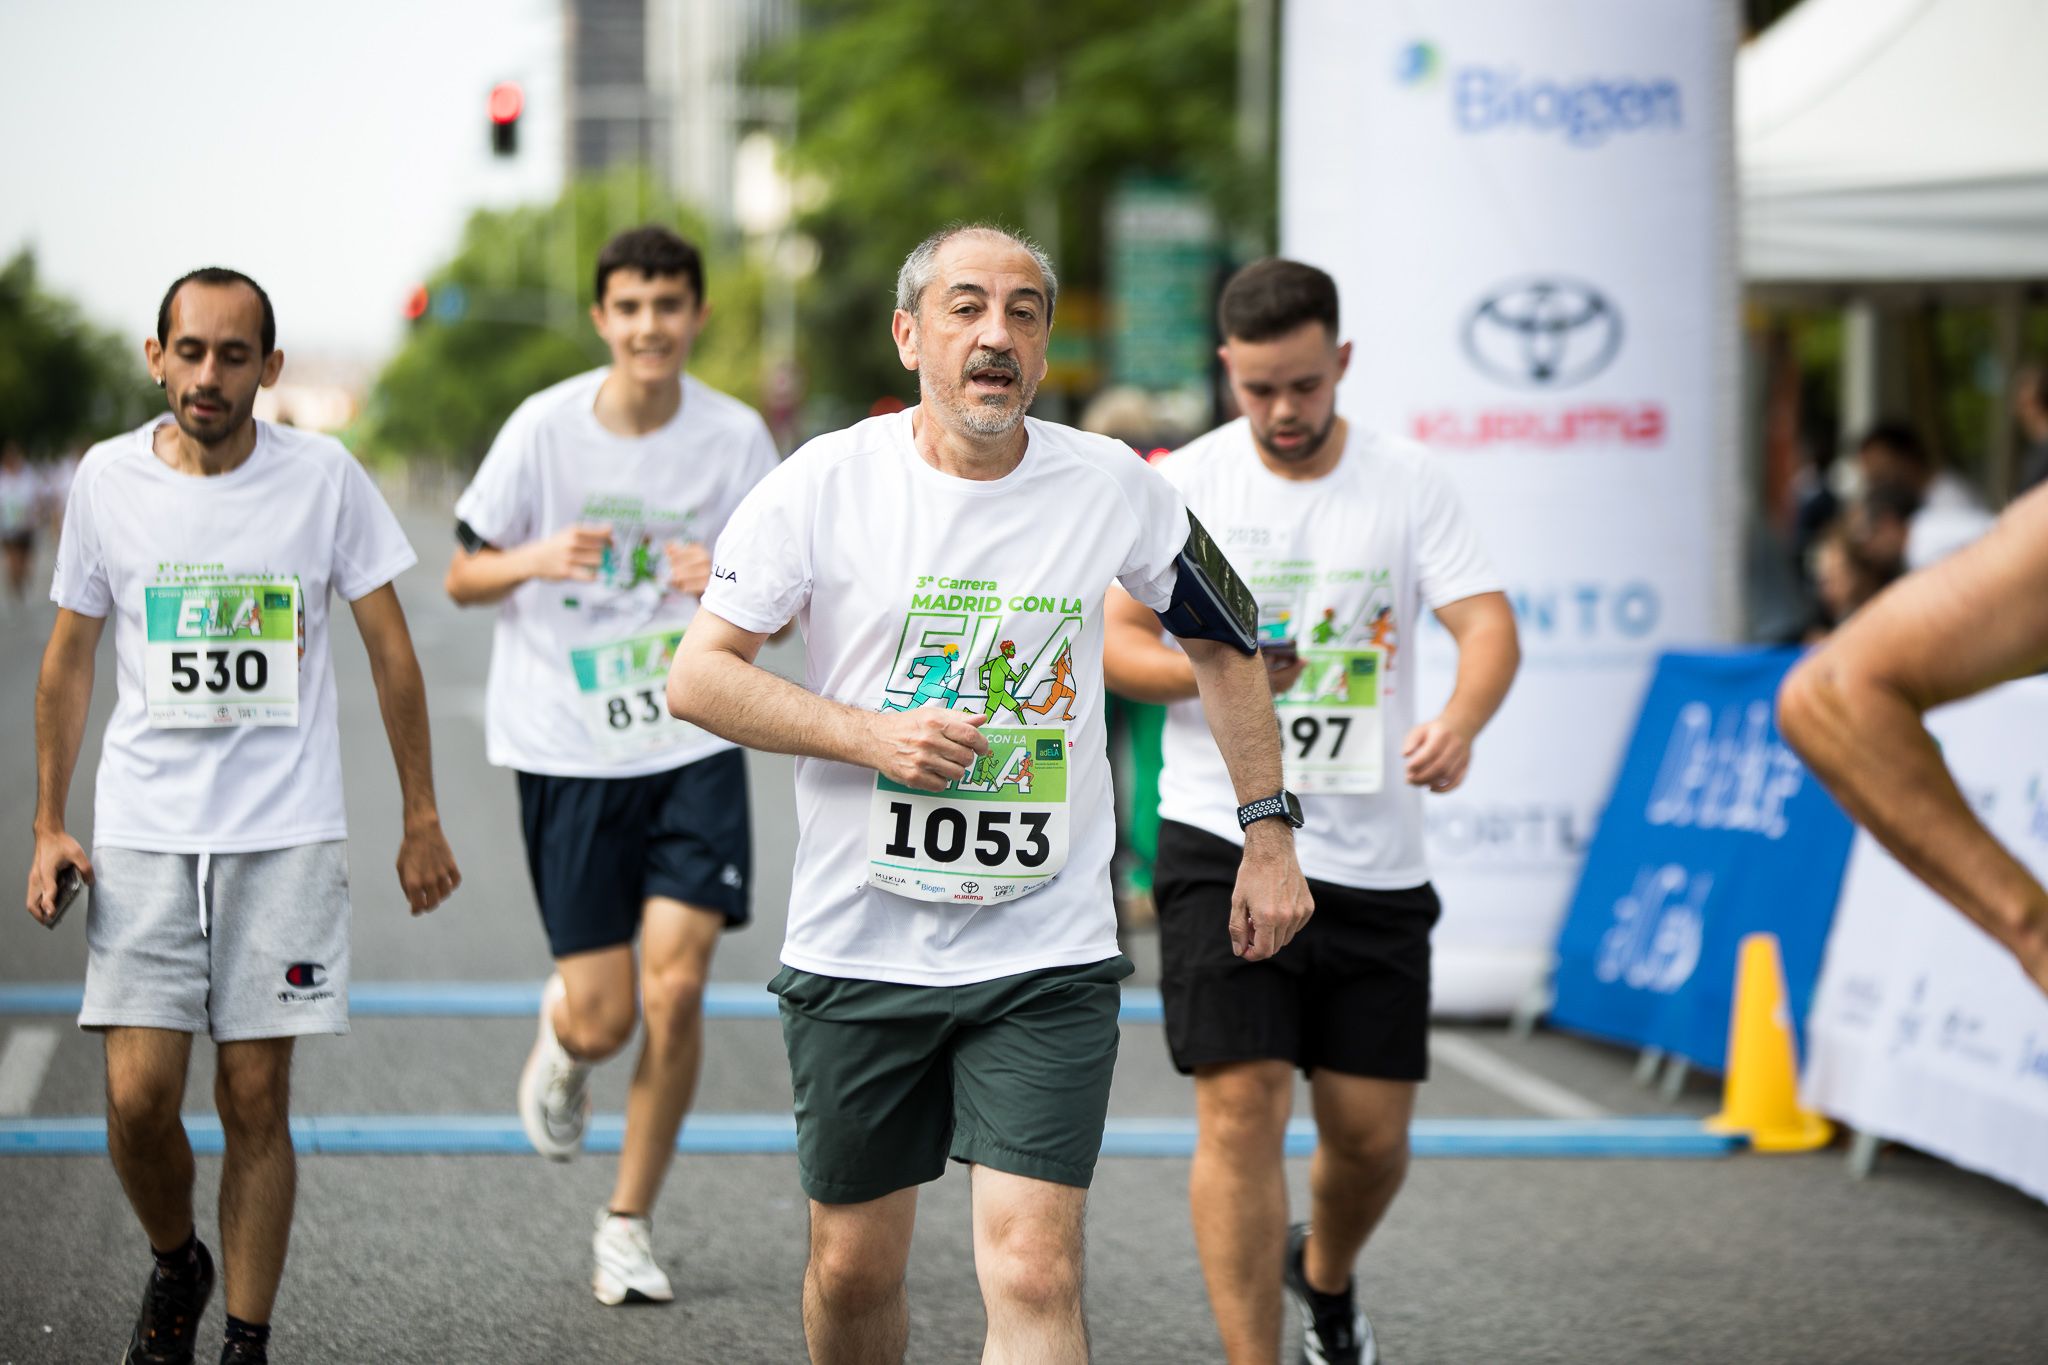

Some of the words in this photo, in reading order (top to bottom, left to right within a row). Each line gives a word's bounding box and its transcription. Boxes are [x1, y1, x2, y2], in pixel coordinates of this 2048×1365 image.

[1453, 65, 1682, 149] Biogen
[911, 594, 1002, 612] MADRID
[1008, 596, 1056, 613] CON
[1060, 598, 1082, 614] LA
[938, 576, 998, 591] Carrera
[176, 598, 262, 638] ELA
[171, 650, 268, 694] 530
[885, 612, 1083, 700] ELA
[608, 684, 667, 730] 83
[986, 734, 1011, 744] CON
[1013, 735, 1026, 745] LA
[1277, 716, 1352, 759] 97
[885, 801, 1052, 868] 1053
[875, 872, 906, 884] MUKUA
[921, 883, 946, 894] Biogen
